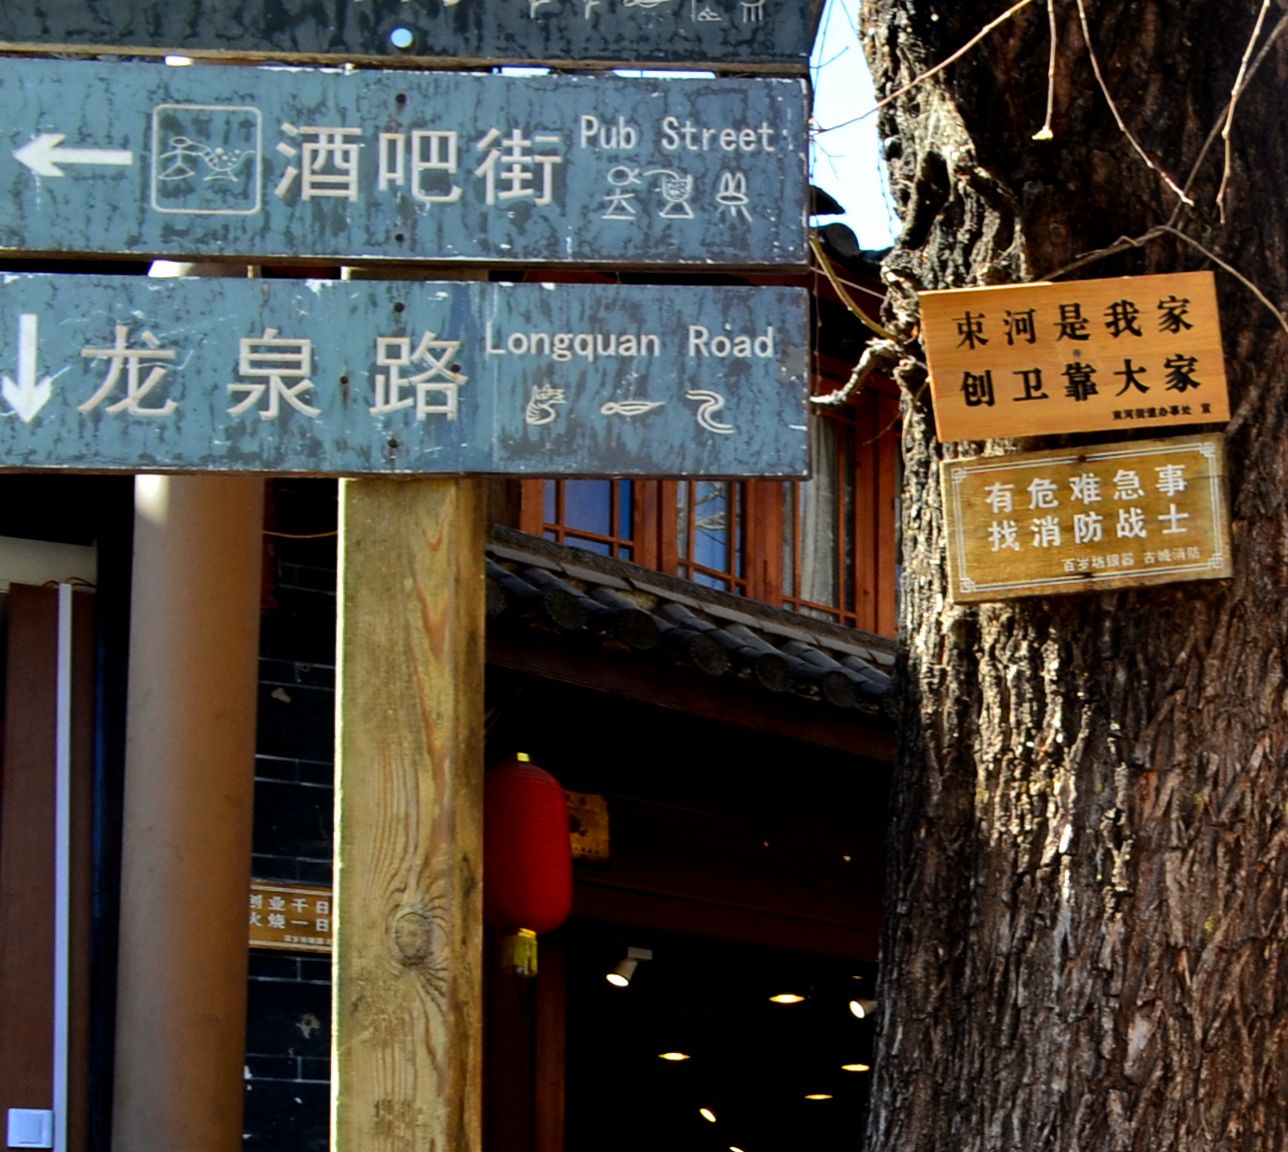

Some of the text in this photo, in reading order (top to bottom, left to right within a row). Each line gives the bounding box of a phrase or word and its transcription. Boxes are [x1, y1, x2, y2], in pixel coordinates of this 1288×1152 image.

[580, 114, 776, 152] Pub Street
[274, 121, 563, 206] 酒吧街
[485, 320, 775, 363] Longquan Road
[952, 295, 1195, 350] 束河是我家
[78, 323, 469, 423] 龙泉路
[960, 353, 1202, 408] 创卫靠大家
[984, 463, 1189, 515] 有危难急事
[987, 502, 1190, 552] 找消防战士
